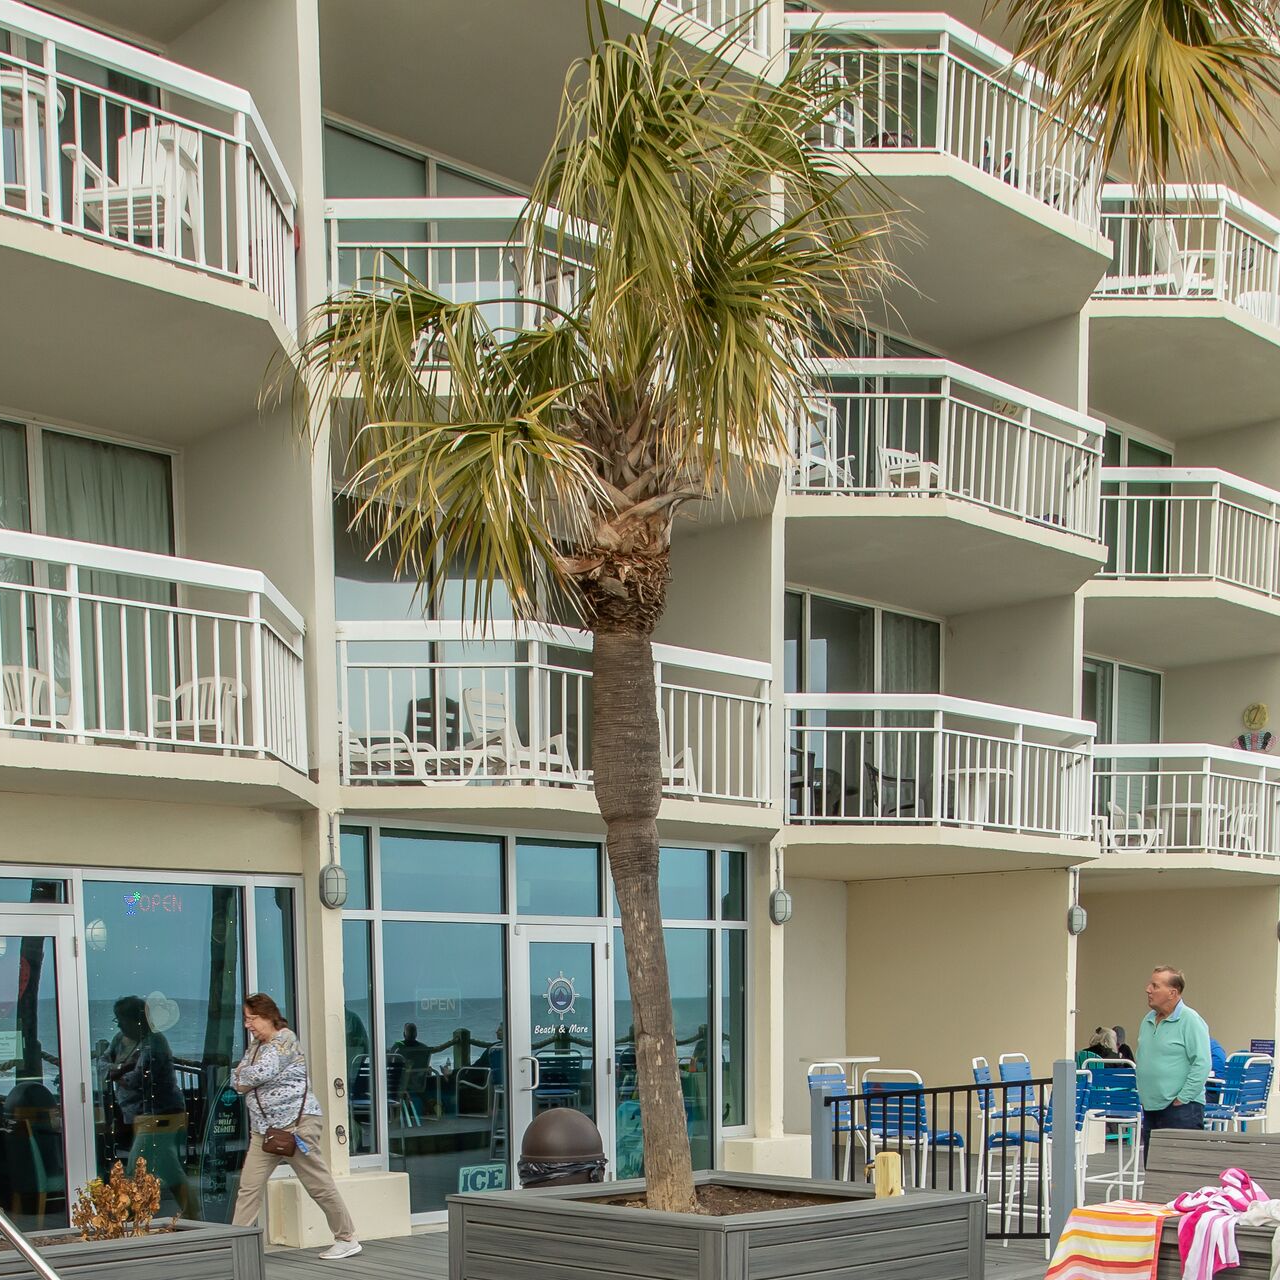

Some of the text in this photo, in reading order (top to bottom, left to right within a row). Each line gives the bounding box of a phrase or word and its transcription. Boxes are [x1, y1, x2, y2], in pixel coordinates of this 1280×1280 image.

[420, 998, 456, 1011] OPEN
[534, 1024, 556, 1035] Beach
[568, 1024, 589, 1034] More
[461, 1169, 503, 1192] ICE
